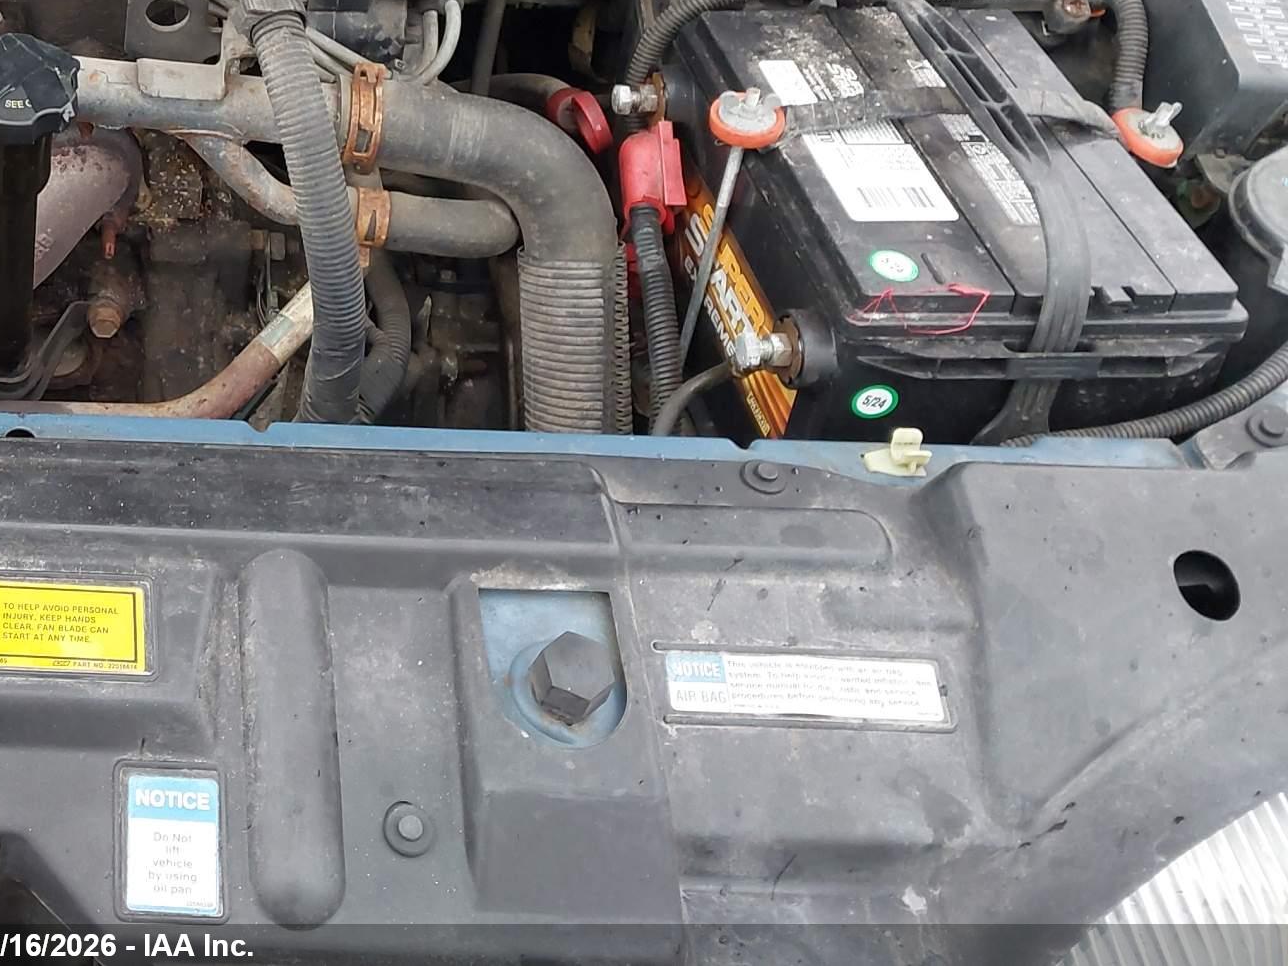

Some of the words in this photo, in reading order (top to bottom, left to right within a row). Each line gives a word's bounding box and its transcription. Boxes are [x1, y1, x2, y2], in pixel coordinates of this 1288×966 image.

[4, 99, 25, 109] SEE
[861, 394, 888, 410] 5/24
[3, 602, 15, 610] TO
[17, 603, 40, 611] HELP
[42, 604, 70, 613] AVOID
[72, 605, 119, 615] PERSONAL
[65, 615, 96, 624] HANDS
[37, 623, 55, 631] FAN
[58, 625, 87, 633] BLADE
[89, 626, 109, 634] CAN
[2, 632, 30, 640] START
[33, 633, 44, 641] AT
[47, 634, 66, 642] ANY
[673, 660, 721, 678] NOTICE
[675, 689, 696, 703] AIR
[701, 690, 727, 704] BAG
[135, 788, 211, 812] NOTICE
[153, 831, 169, 842] Do
[172, 833, 192, 843] Not
[165, 845, 180, 855] lift
[152, 858, 193, 868] vehicle
[148, 869, 162, 881] by
[165, 872, 198, 884] using
[153, 884, 167, 892] oil
[170, 885, 192, 896] pan
